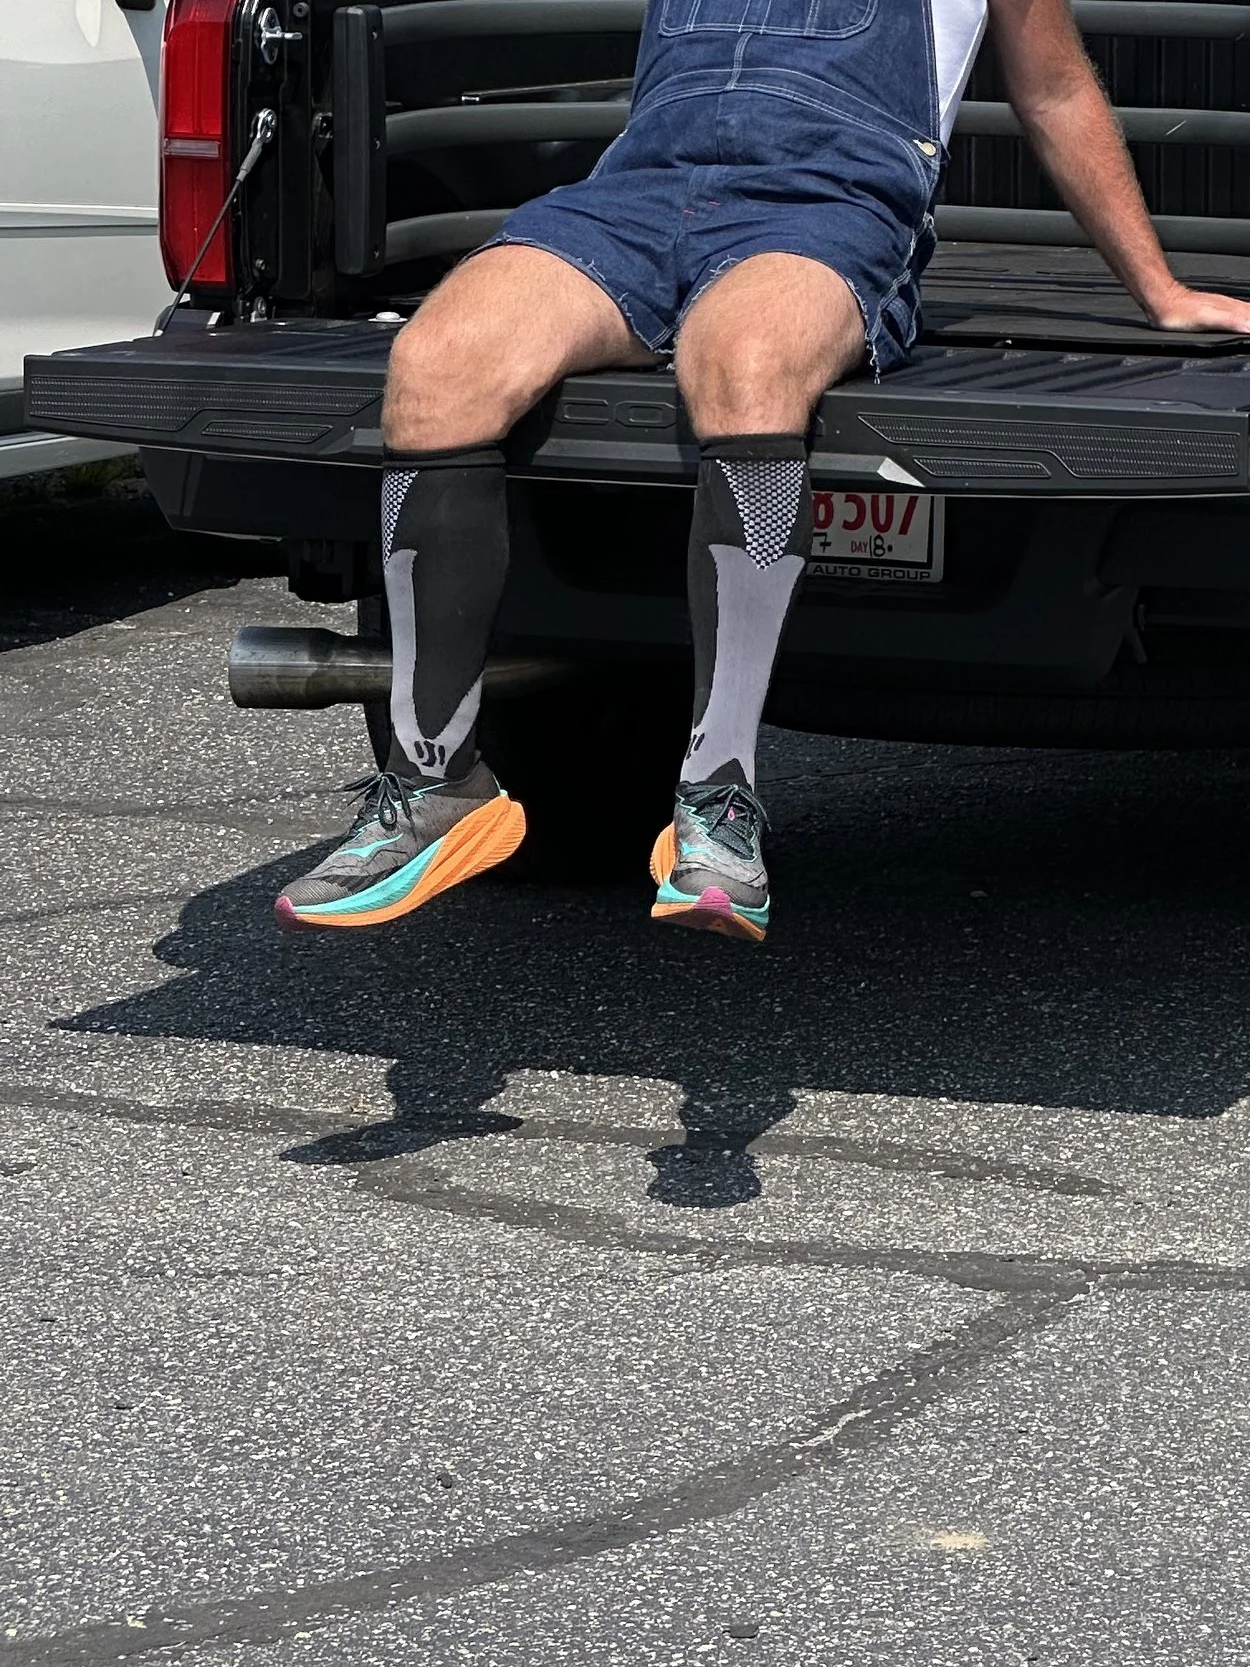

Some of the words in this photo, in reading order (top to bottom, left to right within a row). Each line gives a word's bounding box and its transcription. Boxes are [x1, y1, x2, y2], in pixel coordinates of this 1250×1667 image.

[850, 540, 868, 554] DAY
[812, 564, 861, 577] AUTO
[867, 567, 931, 581] GROUP
